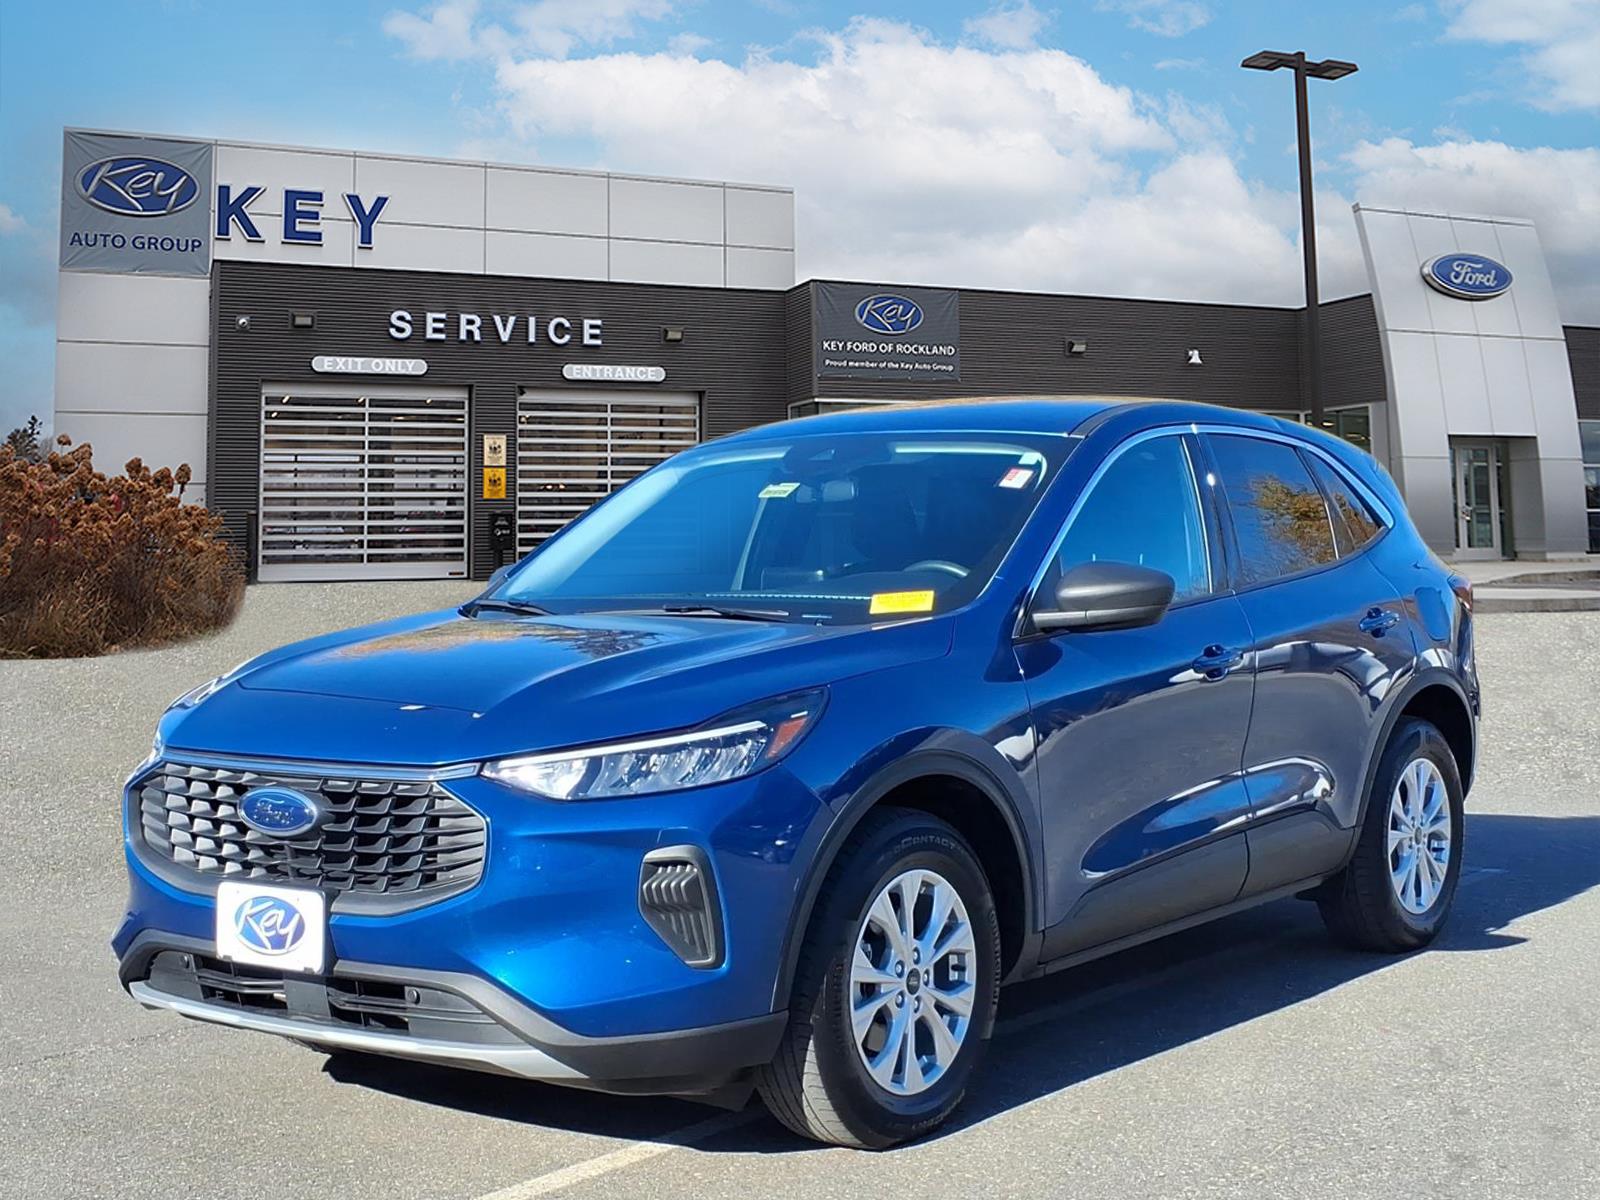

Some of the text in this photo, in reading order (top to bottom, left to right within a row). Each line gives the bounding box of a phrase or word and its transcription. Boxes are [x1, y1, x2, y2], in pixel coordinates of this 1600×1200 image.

[86, 163, 188, 213] Key
[215, 184, 391, 250] KEY
[69, 231, 203, 253] AUTO GROUP
[1450, 260, 1497, 287] Ford
[388, 309, 604, 346] SERVICE
[862, 299, 917, 332] Key
[822, 340, 956, 356] KEY FORD OF ROCKLAND
[323, 358, 415, 372] EXIT ONLY
[573, 365, 657, 380] ENTRANCE
[825, 359, 954, 373] Proud member of the Key Auto Group
[237, 899, 304, 951] Key
